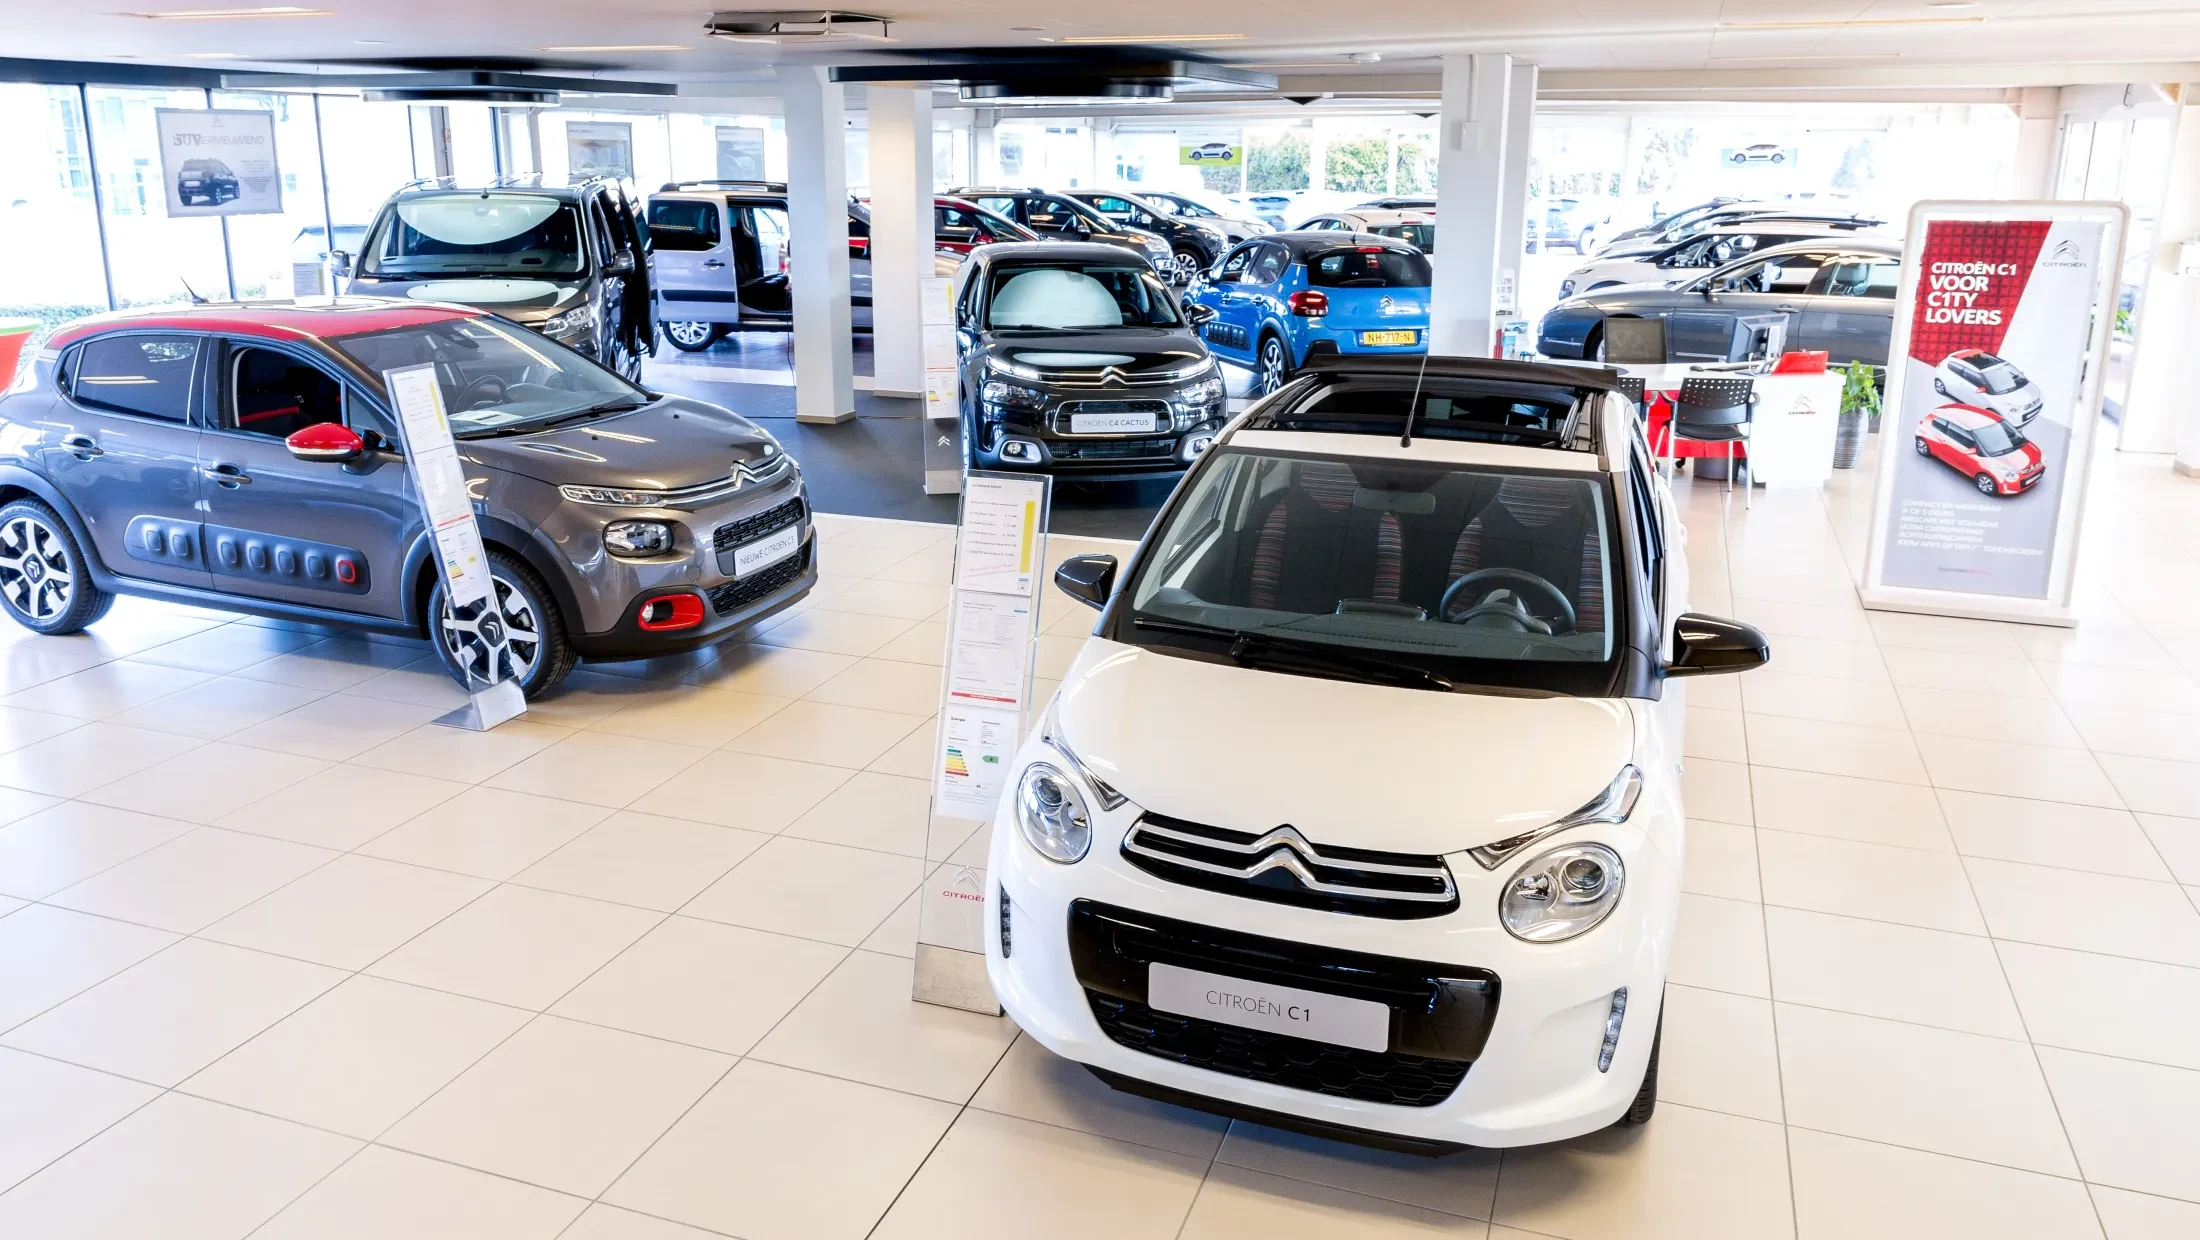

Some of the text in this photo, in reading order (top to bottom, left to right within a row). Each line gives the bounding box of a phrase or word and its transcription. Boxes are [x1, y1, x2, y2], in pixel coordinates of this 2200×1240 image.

[1931, 261, 2017, 276] CITROËN C1
[1930, 275, 1988, 292] VOOR
[1928, 291, 1978, 308] C1TY
[1925, 308, 2002, 326] LOVERS
[1368, 332, 1410, 343] NH-717-N
[1108, 419, 1119, 427] C4
[1206, 990, 1310, 1022] CITROËN C1
